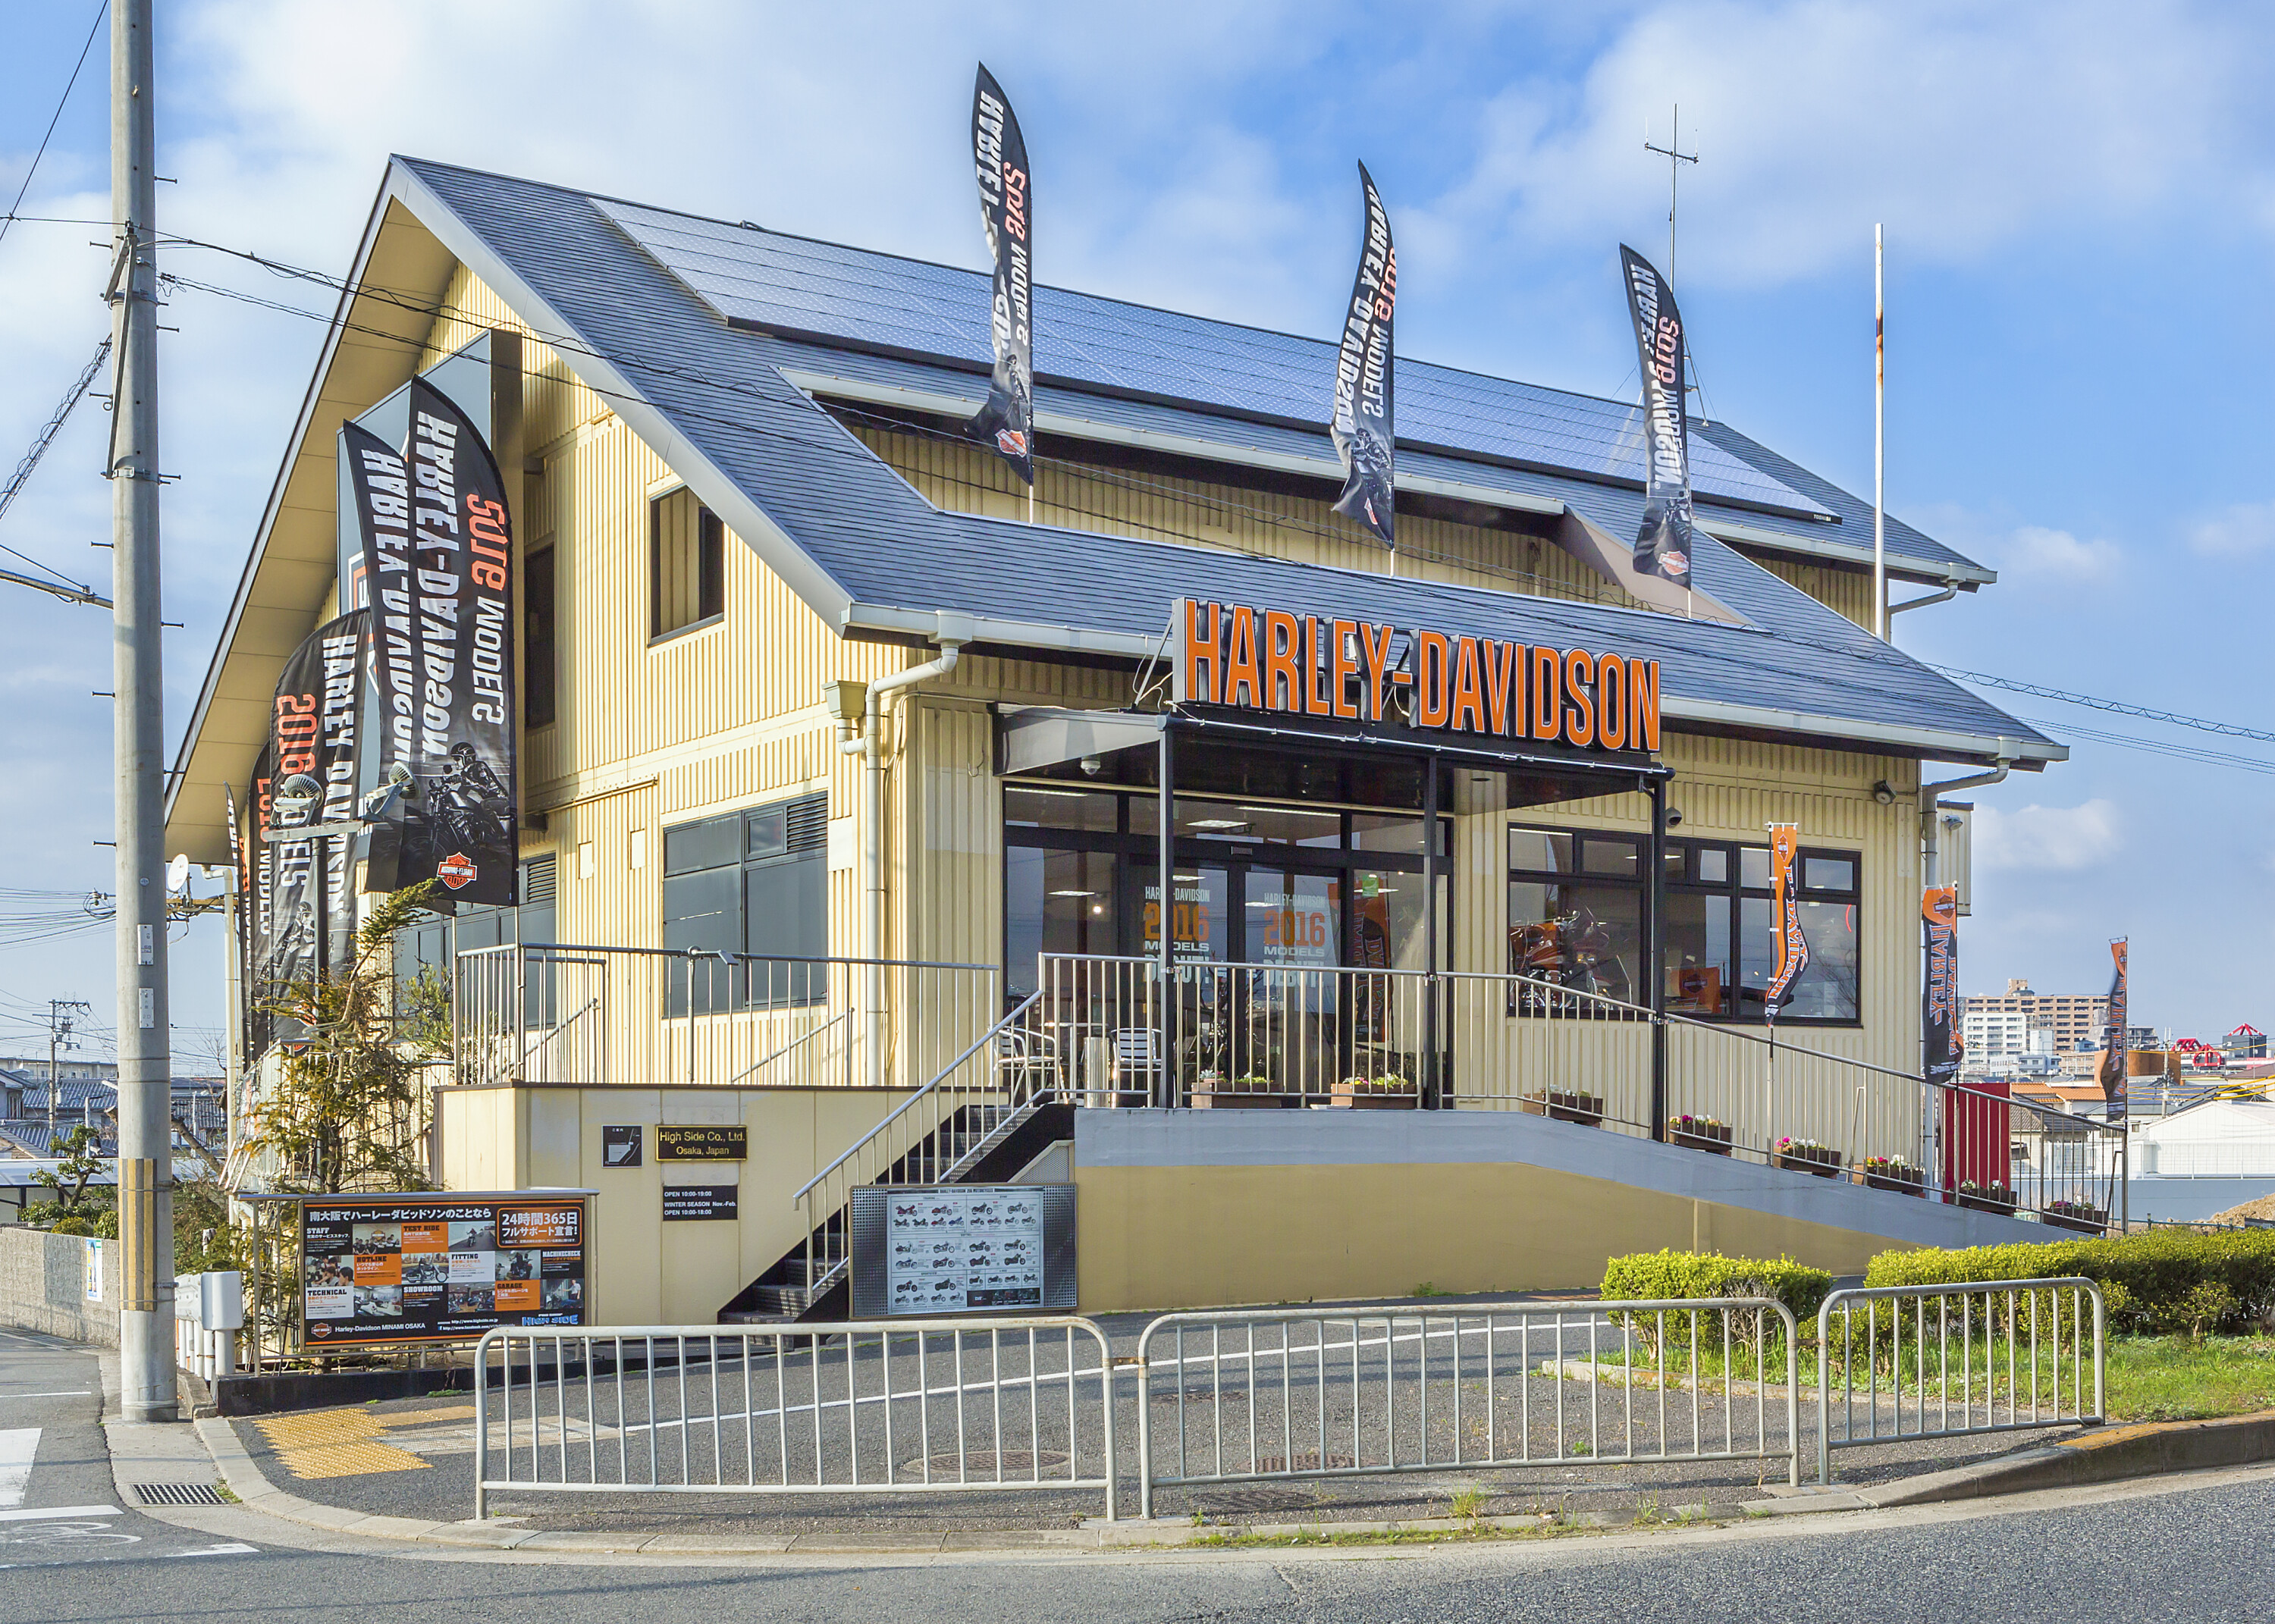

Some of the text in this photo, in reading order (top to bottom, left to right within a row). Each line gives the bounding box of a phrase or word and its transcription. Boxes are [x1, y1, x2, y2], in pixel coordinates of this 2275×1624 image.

[1183, 596, 1662, 753] HARLEY-DAVIDSON
[277, 693, 317, 776] 2016
[322, 633, 358, 914] HARLEYDAVDSON
[1145, 886, 1210, 902] HAR-DAVIDSON
[1264, 892, 1326, 908] HARLEY-DAVIDSON
[1263, 910, 1326, 947] 2016
[1144, 940, 1210, 952] MDELS
[1263, 946, 1326, 957] MODELS
[1768, 898, 1800, 999] DAVIDSON
[660, 1131, 745, 1143] High Side Co., Ltd.
[676, 1146, 730, 1156] Osaka, Japan
[309, 1208, 491, 1221] 南大阪でハーレーダビッドソンのことなら
[501, 1212, 577, 1226] 24時間365日
[522, 1313, 579, 1327] HIGH SIDE
[334, 1325, 381, 1333] Harley-Davidson
